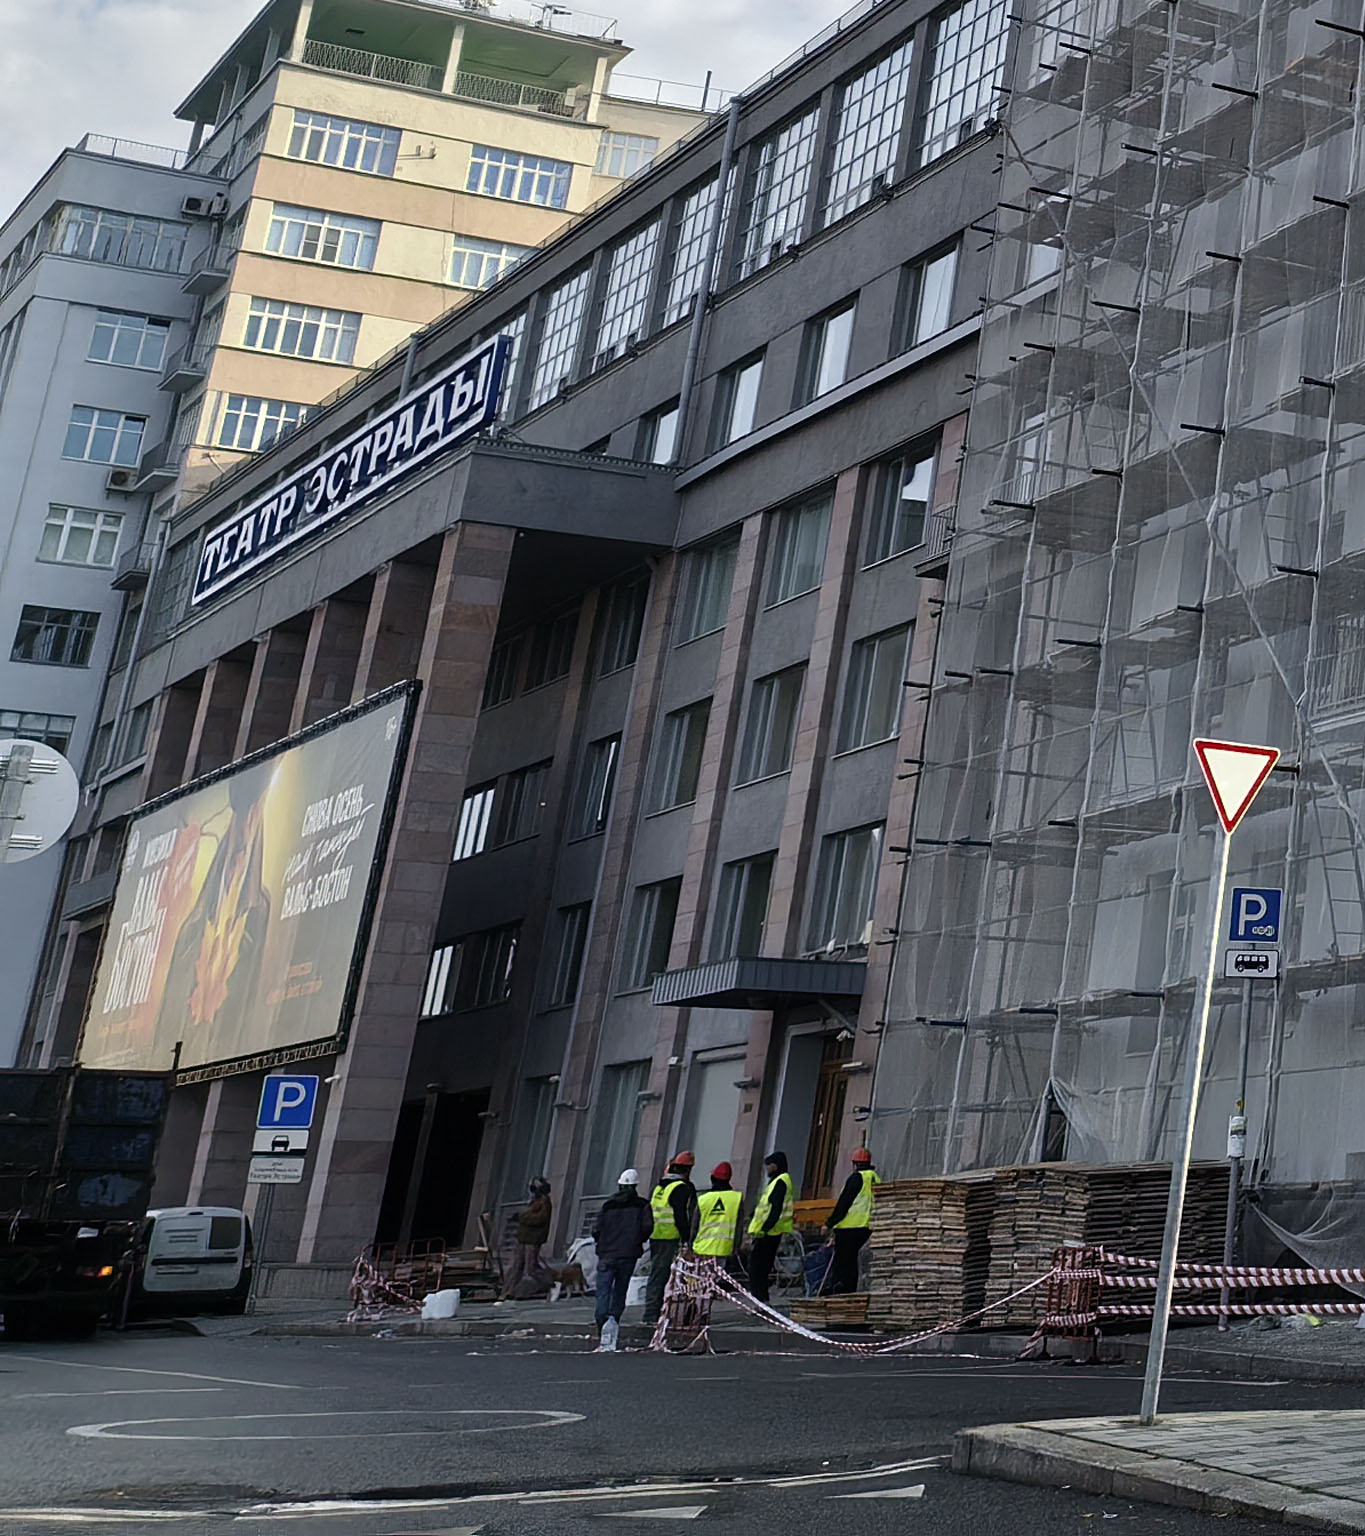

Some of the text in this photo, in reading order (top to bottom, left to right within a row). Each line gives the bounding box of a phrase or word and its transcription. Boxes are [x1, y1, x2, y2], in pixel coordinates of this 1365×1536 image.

[202, 353, 491, 583] ТЕАТР ЭСТРАДЫ
[1238, 893, 1267, 936] P
[273, 1081, 306, 1122] P
